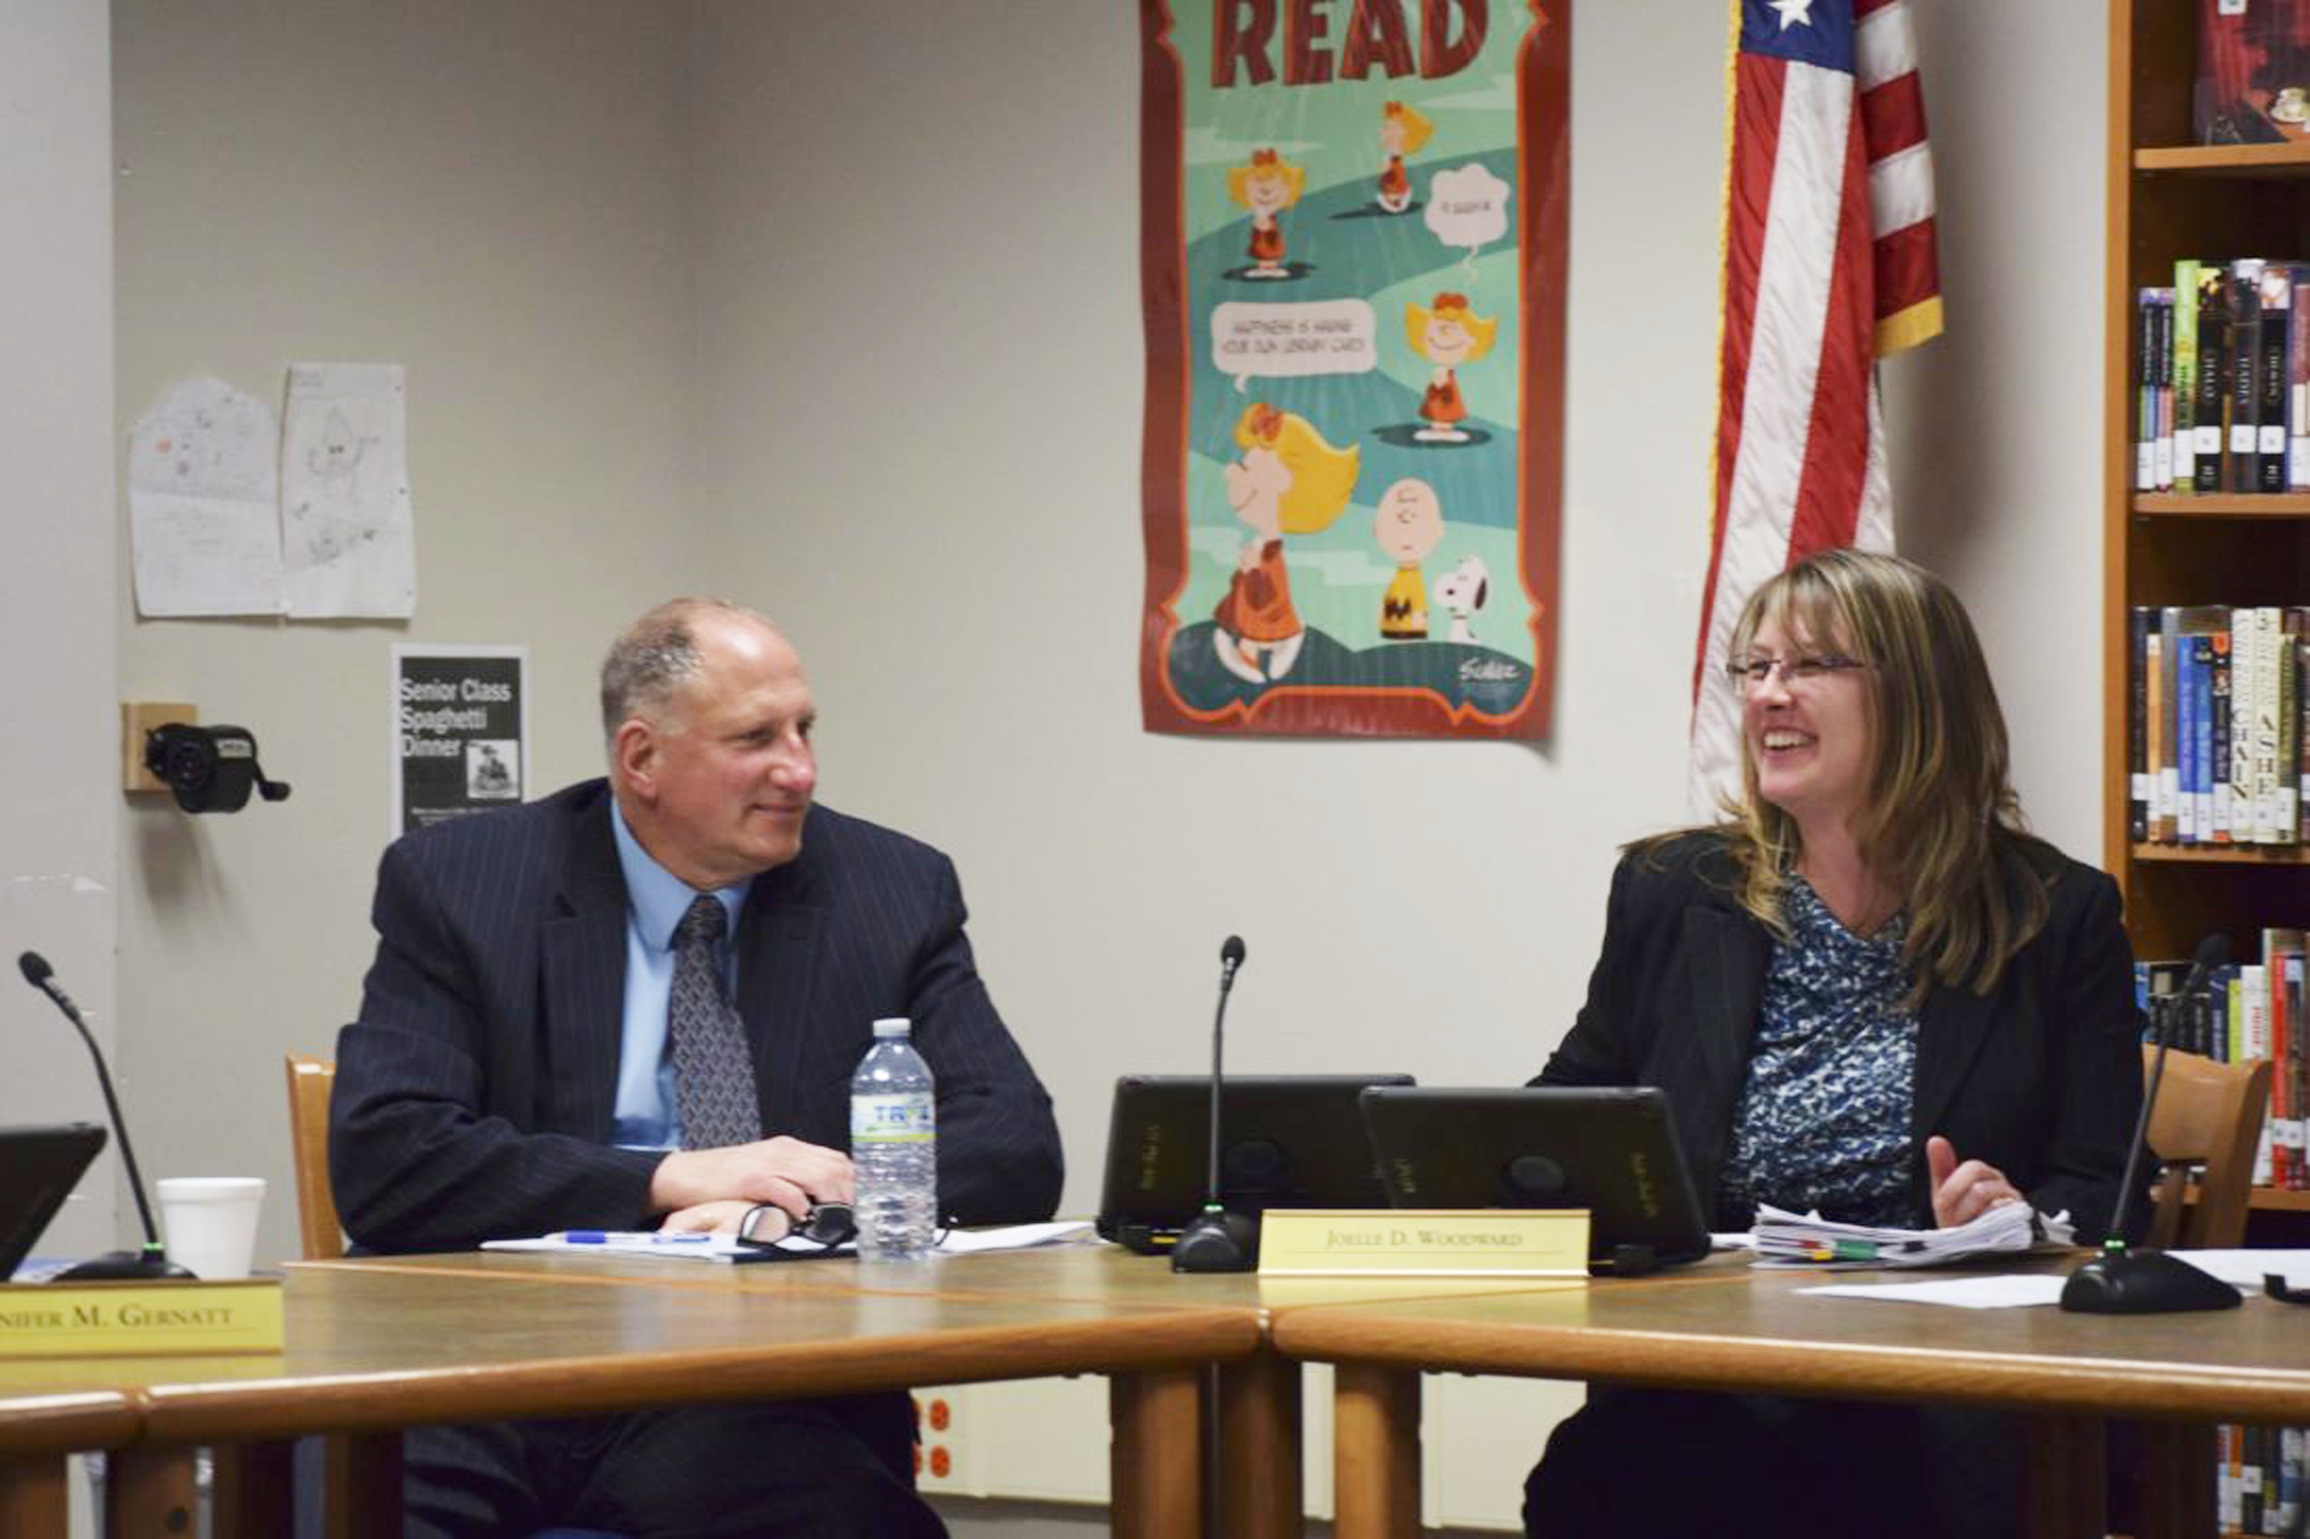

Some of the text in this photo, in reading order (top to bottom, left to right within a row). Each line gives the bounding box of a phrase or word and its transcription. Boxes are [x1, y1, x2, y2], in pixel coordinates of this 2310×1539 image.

[1211, 0, 1488, 88] READ
[401, 678, 511, 701] Senior Class
[401, 706, 487, 735] Spaghetti
[401, 733, 461, 757] Dinner
[1390, 1230, 1412, 1247] D.
[73, 1304, 109, 1327] M.
[117, 1302, 235, 1328] GERNATT
